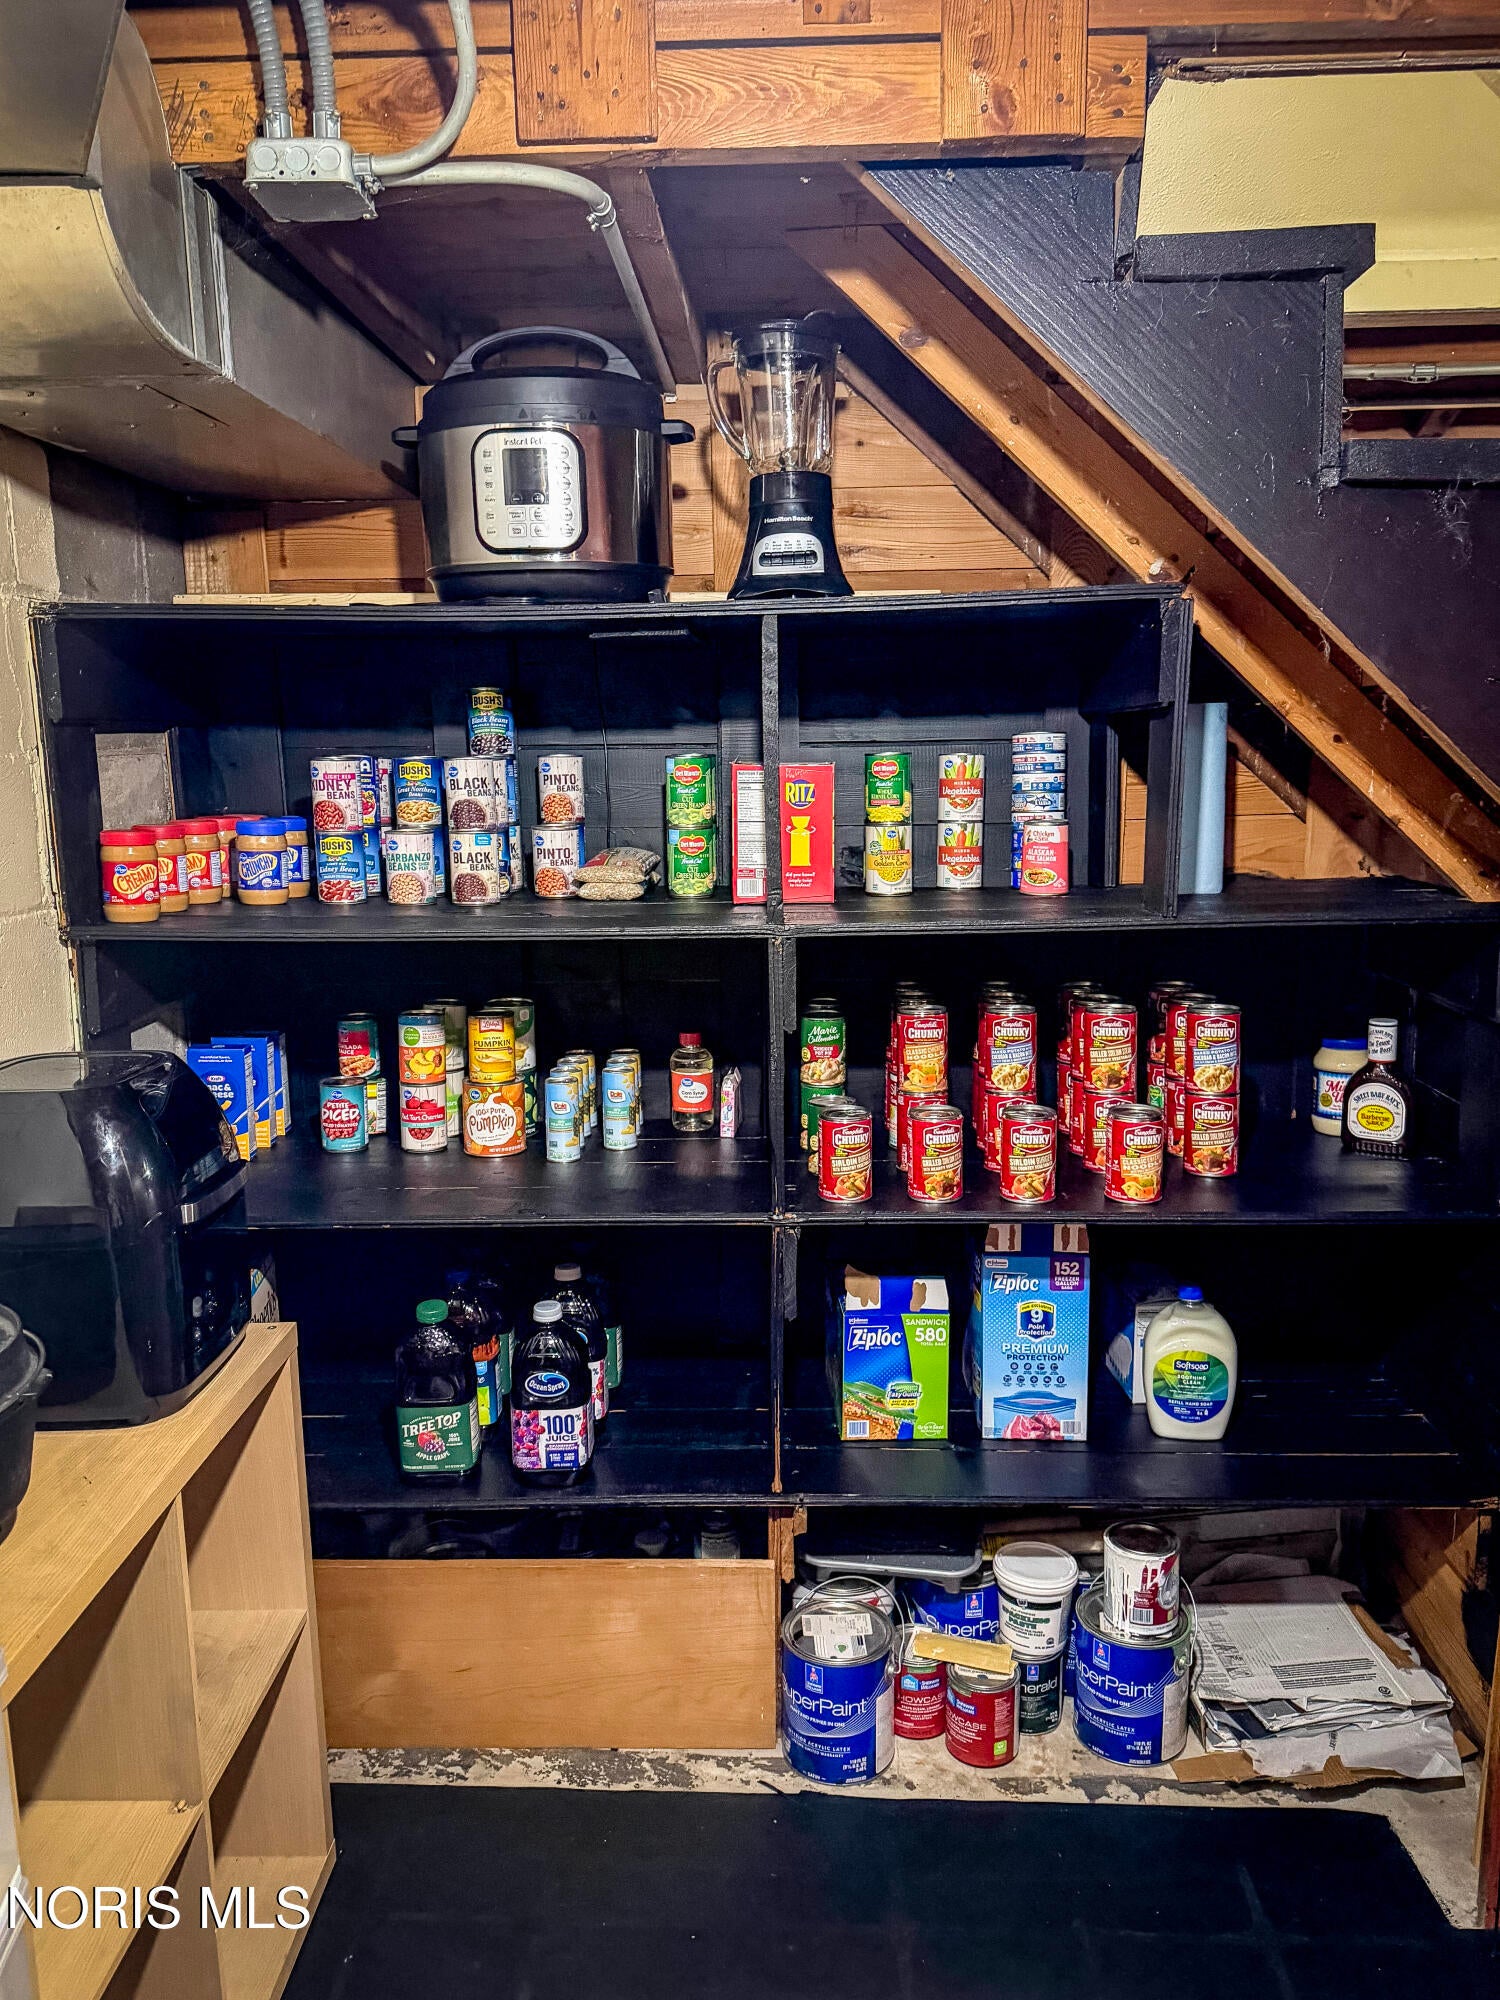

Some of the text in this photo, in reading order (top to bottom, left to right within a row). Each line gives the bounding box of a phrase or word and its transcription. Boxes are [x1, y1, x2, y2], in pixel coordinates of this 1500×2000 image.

[764, 516, 792, 524] Hamilton
[472, 695, 503, 706] BUSH'S
[489, 716, 508, 724] Beans
[400, 766, 430, 776] BUSH'S
[312, 780, 351, 792] KIDNEY
[450, 778, 488, 790] BLACK
[543, 774, 576, 786] PINTO
[467, 788, 492, 797] BEANS
[556, 784, 580, 792] BEANS
[786, 782, 816, 803] RITZ
[942, 786, 980, 798] Vegetables
[326, 791, 356, 800] BEANS
[321, 841, 352, 851] BUSH'S
[1028, 848, 1054, 856] ALASKAN
[386, 852, 431, 862] GARBANZO
[453, 852, 491, 864] BLACK
[536, 848, 570, 860] PINTO
[942, 854, 980, 866] Vegetables
[241, 855, 274, 878] CRUNCHY
[388, 862, 416, 871] BEANS
[469, 863, 495, 872] BEANS
[550, 858, 574, 866] BEANS
[117, 866, 154, 892] CREAMY
[810, 1026, 838, 1036] Marie
[908, 1028, 943, 1040] CHUNKY
[994, 1026, 1030, 1038] CHUNKY
[1094, 1026, 1129, 1038] CHUNKY
[1198, 1026, 1234, 1038] CHUNKY
[474, 1039, 510, 1048] PUMPKIN
[906, 1052, 944, 1060] NOODLE
[610, 1090, 623, 1098] Dole
[1354, 1091, 1401, 1108] SWEET BABY RAY'S
[554, 1102, 566, 1110] Dole
[322, 1108, 358, 1122] DICED
[1194, 1108, 1232, 1121] CHUNKY
[1360, 1112, 1390, 1122] Barbecue
[834, 1132, 868, 1145] CHUNKY
[926, 1132, 960, 1145] CHUNKY
[1012, 1132, 1050, 1144] CHUNKY
[1126, 1134, 1162, 1146] CHUNKY
[832, 1157, 858, 1168] SIRLOIN
[1010, 1158, 1036, 1166] SIRLOIN
[1054, 1261, 1080, 1276] 152
[994, 1274, 1040, 1295] Ziploc
[906, 1318, 946, 1326] SANDWICH
[1030, 1310, 1043, 1323] 9
[914, 1327, 946, 1342] 580
[1018, 1328, 1054, 1336] Protection
[852, 1329, 902, 1351] Ziploc
[1002, 1344, 1070, 1354] PREMIUM
[1006, 1354, 1064, 1362] PROTECTION
[1176, 1360, 1209, 1372] Softsoap
[529, 1380, 565, 1392] Ocean Spray
[435, 1412, 462, 1428] TOP
[546, 1434, 577, 1442] JUICE
[416, 1450, 450, 1461] APPLE GRAPE
[1002, 1604, 1050, 1624] SPACKLING
[926, 1614, 1000, 1637] SuperPa
[1008, 1618, 1038, 1630] PASTE
[1077, 1656, 1154, 1698] uperPaint
[782, 1672, 866, 1717] SuperPaint
[810, 1716, 827, 1726] PRIMER
[1093, 1714, 1136, 1733] ACRYLIC LATEX
[808, 1740, 830, 1751] ACRYLIC
